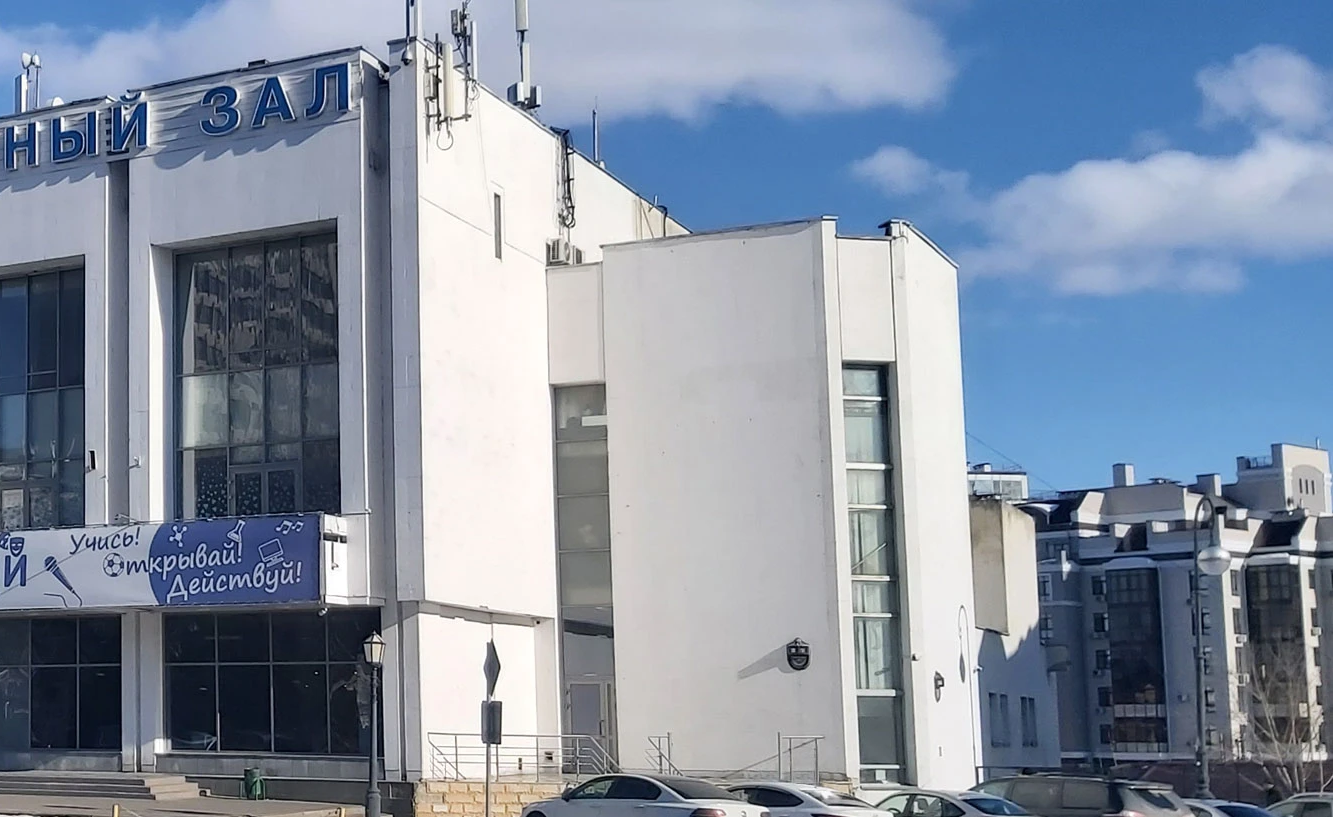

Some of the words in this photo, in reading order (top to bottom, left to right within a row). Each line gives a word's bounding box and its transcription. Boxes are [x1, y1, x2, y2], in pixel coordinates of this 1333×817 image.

[199, 62, 353, 137] ЗАЛ
[69, 526, 141, 554] Учись!
[167, 561, 303, 602] Действуй!
